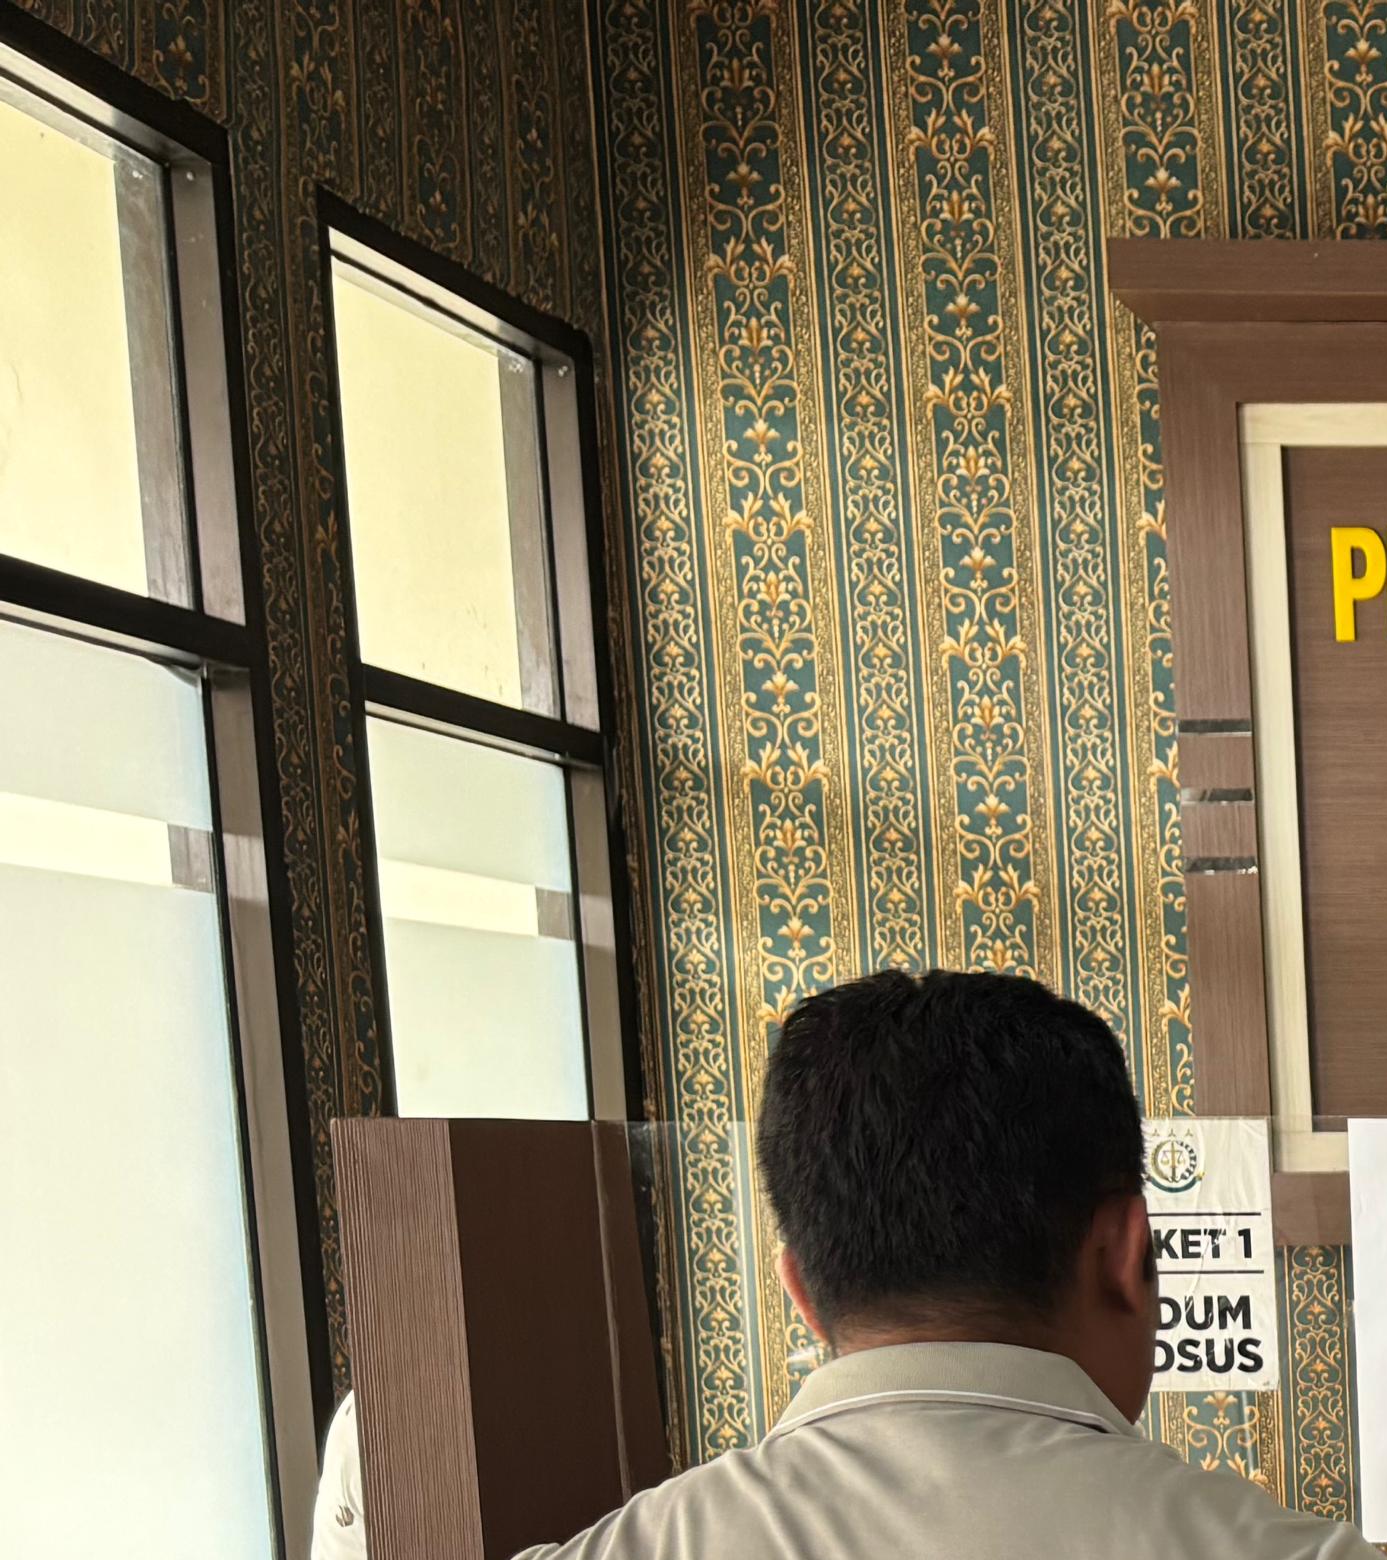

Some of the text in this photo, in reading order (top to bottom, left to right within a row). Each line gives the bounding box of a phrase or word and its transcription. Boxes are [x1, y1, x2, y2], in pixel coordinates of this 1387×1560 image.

[1153, 1228, 1252, 1259] KET 1
[1158, 1295, 1252, 1331] DUM
[1153, 1337, 1264, 1374] DSUS
